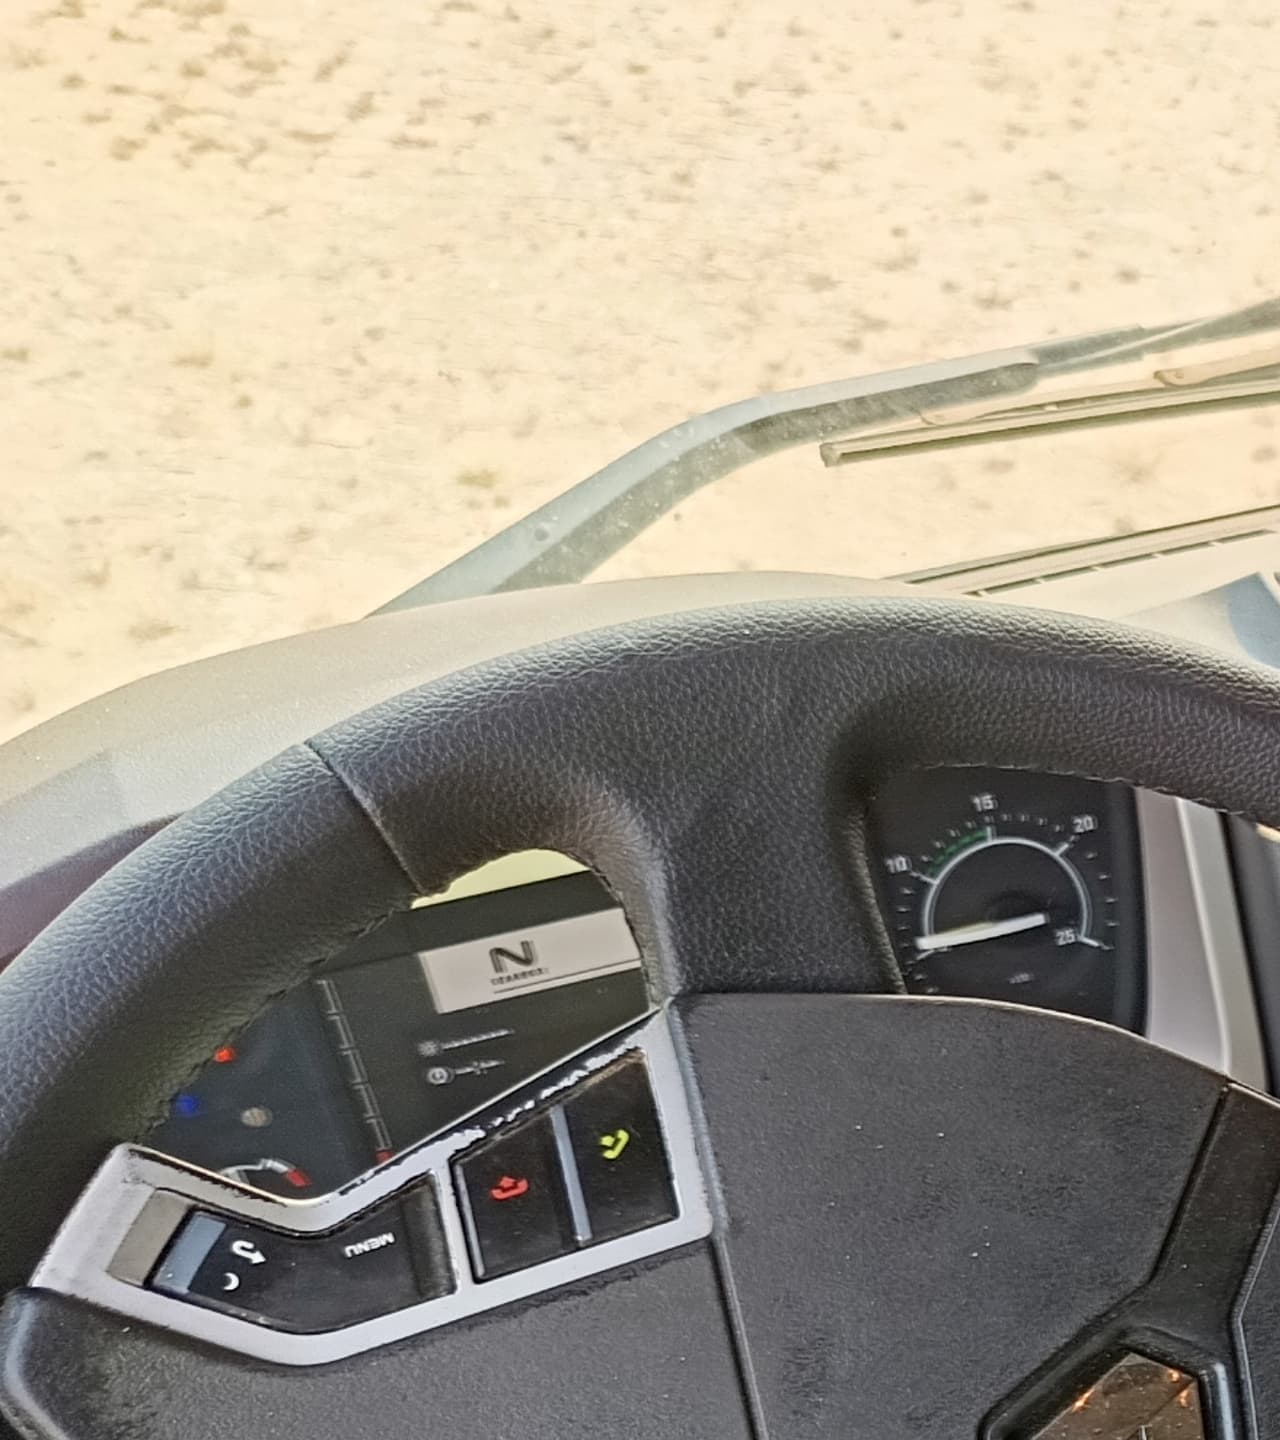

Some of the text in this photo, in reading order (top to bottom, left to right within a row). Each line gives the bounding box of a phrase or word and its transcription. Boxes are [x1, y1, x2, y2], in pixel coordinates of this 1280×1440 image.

[1073, 816, 1094, 832] 20
[489, 940, 535, 973] N
[344, 1232, 395, 1258] MENU
